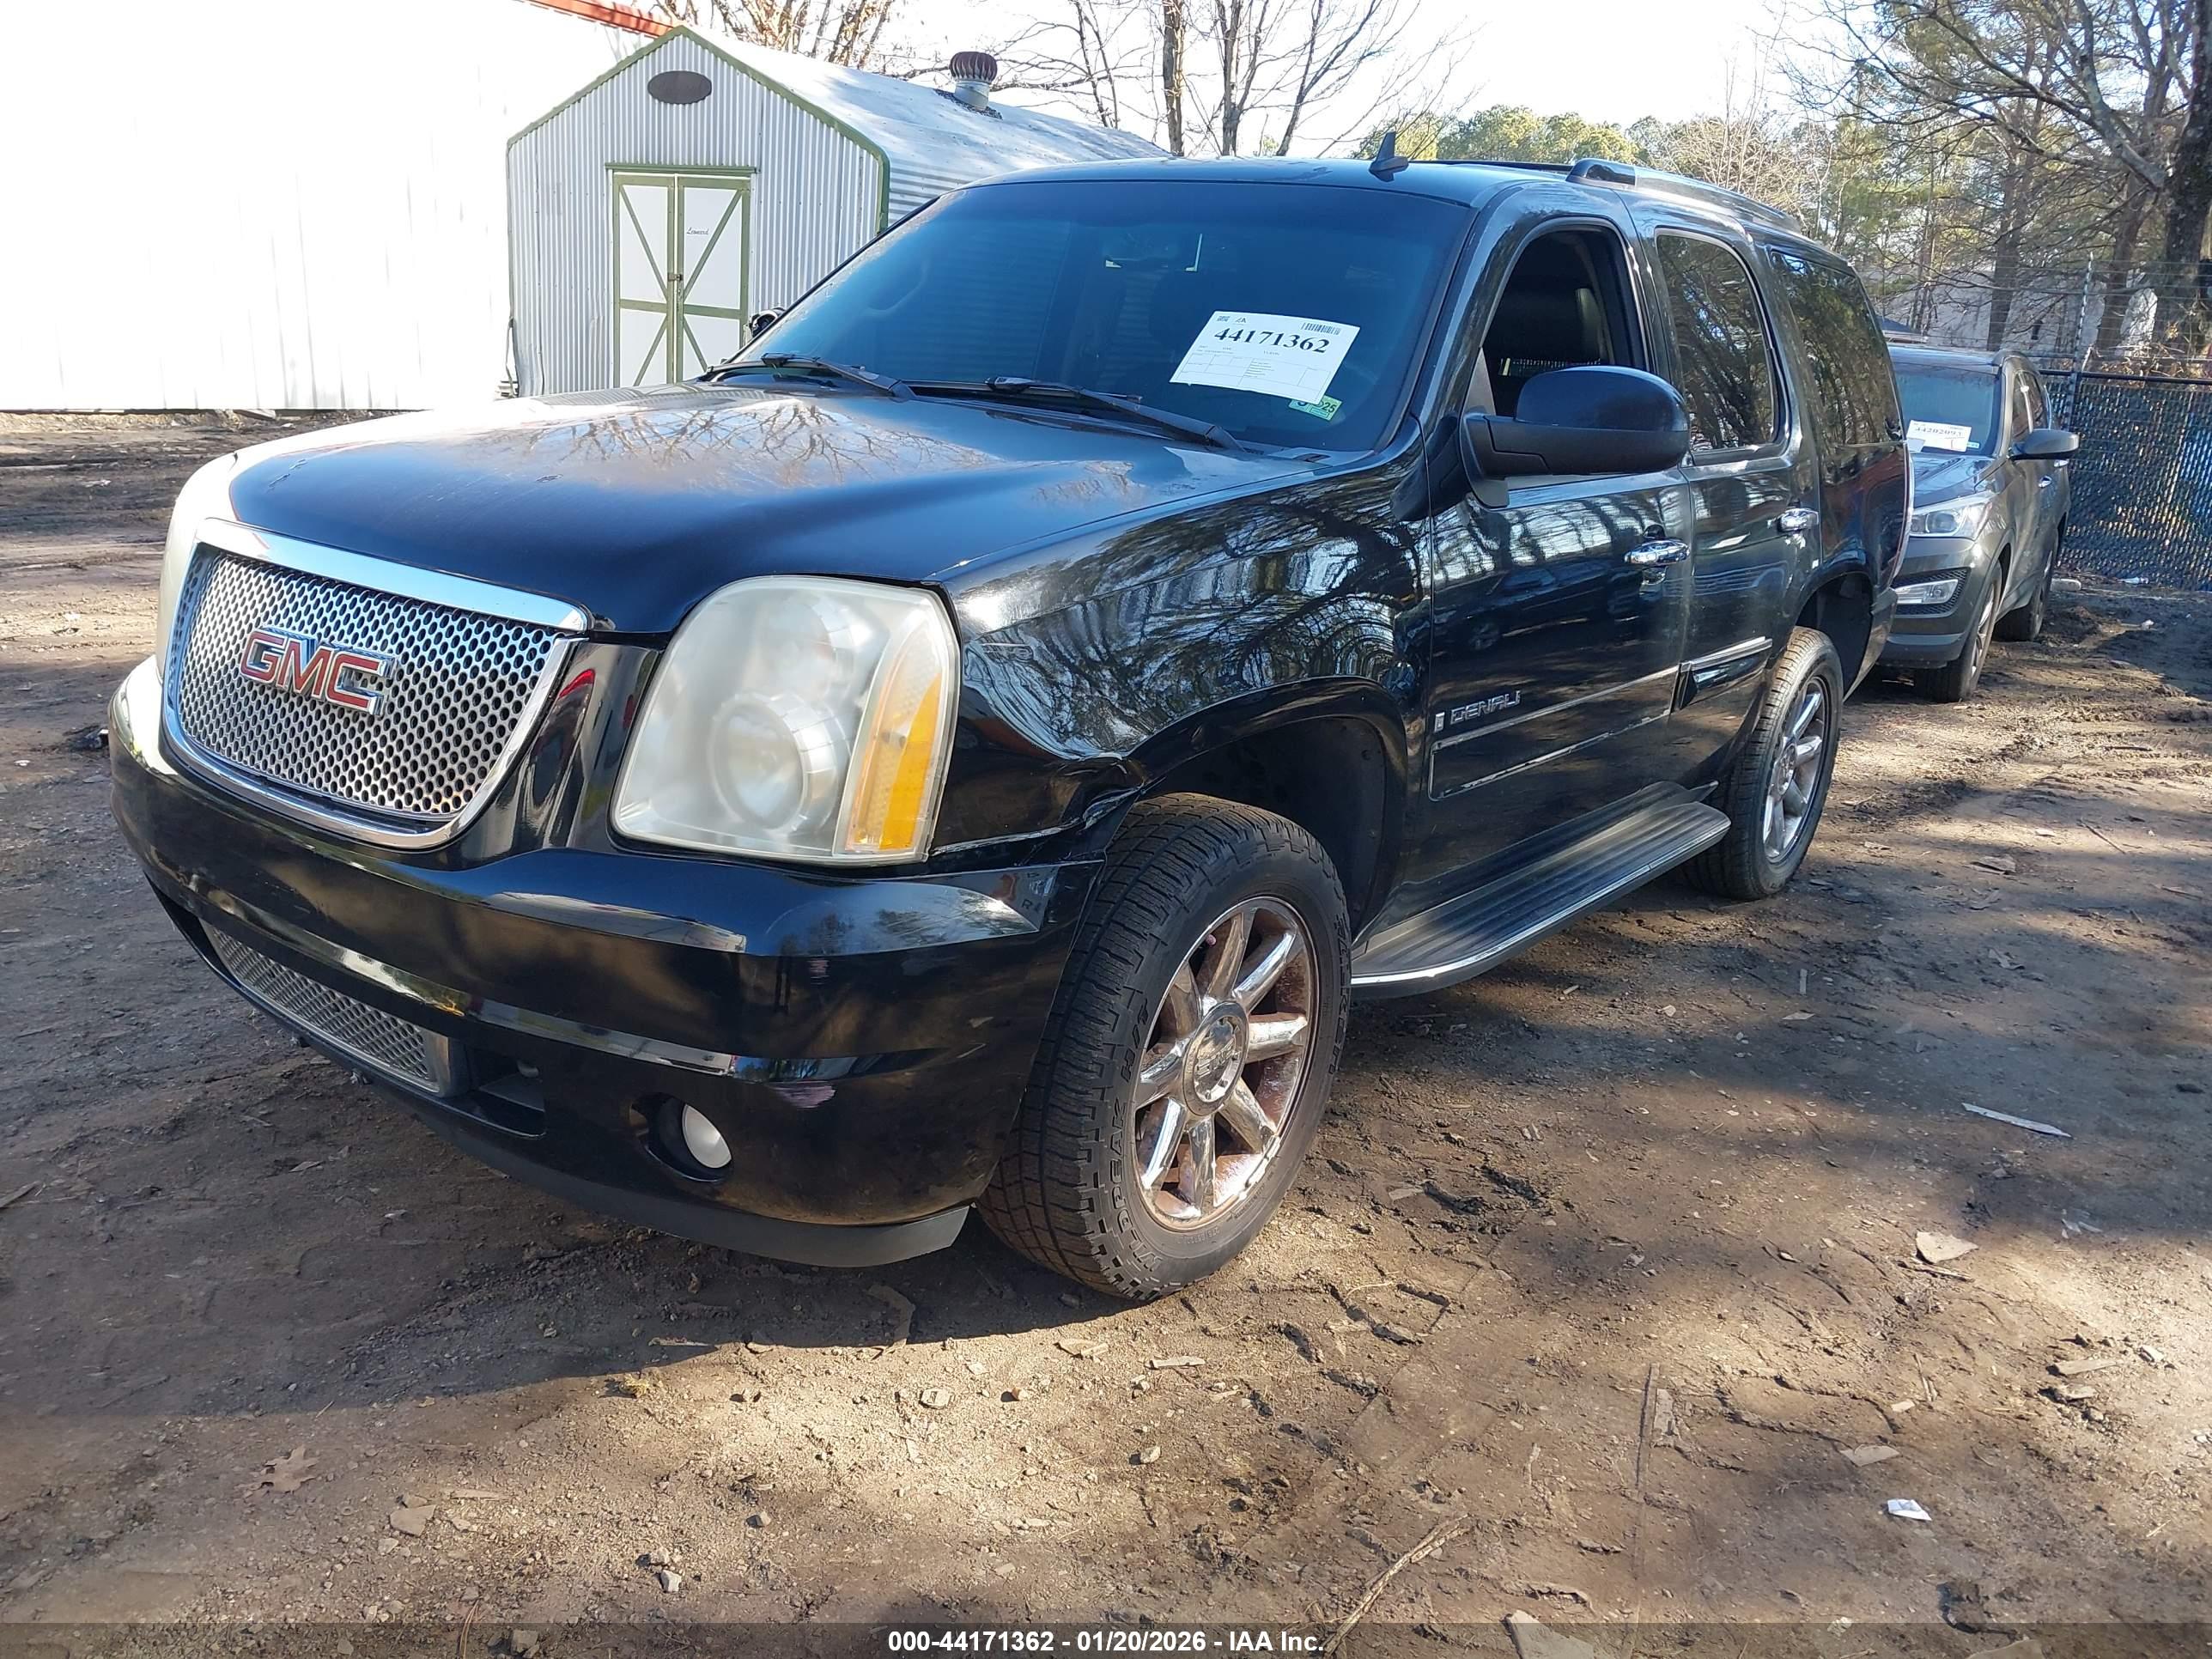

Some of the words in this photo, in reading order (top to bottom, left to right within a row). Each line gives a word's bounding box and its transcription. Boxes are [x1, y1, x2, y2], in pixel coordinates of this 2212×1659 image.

[1213, 327, 1330, 354] 44171362
[240, 628, 397, 716] GMC
[1450, 690, 1522, 725] DENALI
[1109, 1097, 1162, 1273] WILDPEAK
